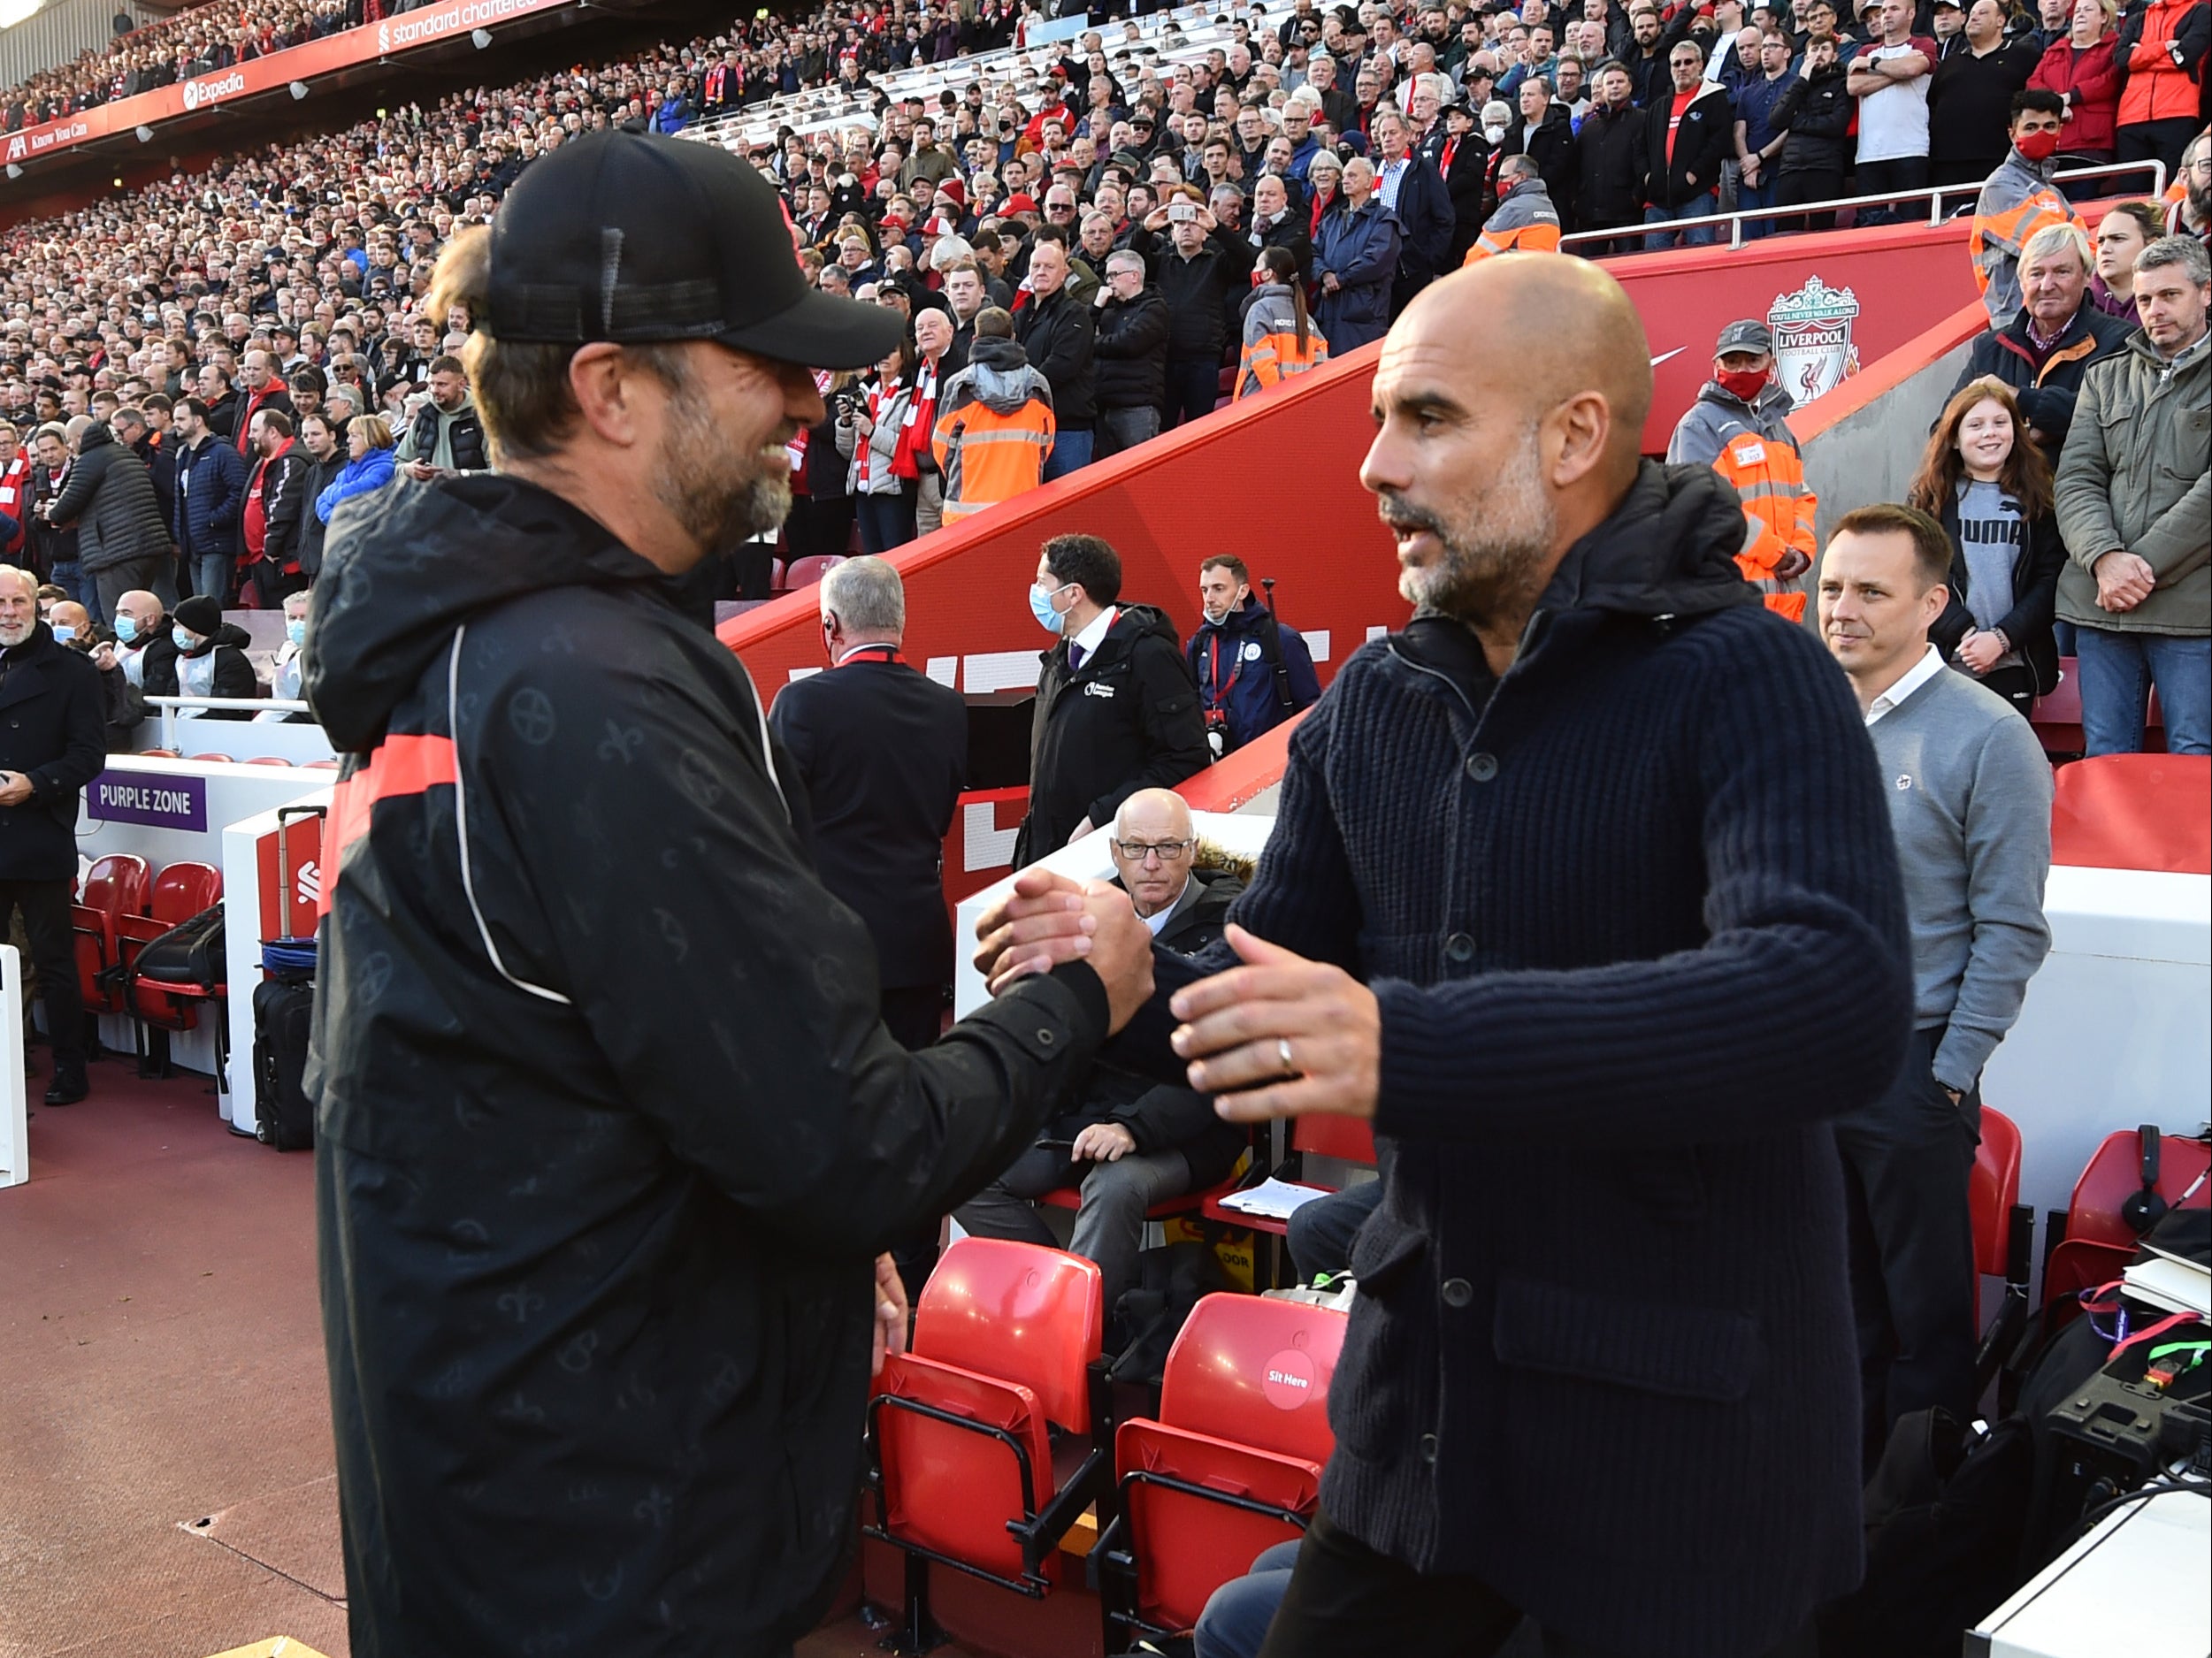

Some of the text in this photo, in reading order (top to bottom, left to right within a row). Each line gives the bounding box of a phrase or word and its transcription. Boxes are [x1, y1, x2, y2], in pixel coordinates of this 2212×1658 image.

[393, 6, 460, 45] standard
[198, 72, 245, 103] Expedia
[6, 122, 88, 161] AXA Know You Can
[1779, 330, 1844, 348] LIVERPOOL
[1780, 348, 1818, 357] FOOTBALL
[99, 784, 191, 814] PURPLE ZONE
[1267, 1370, 1308, 1388] Sit Here
